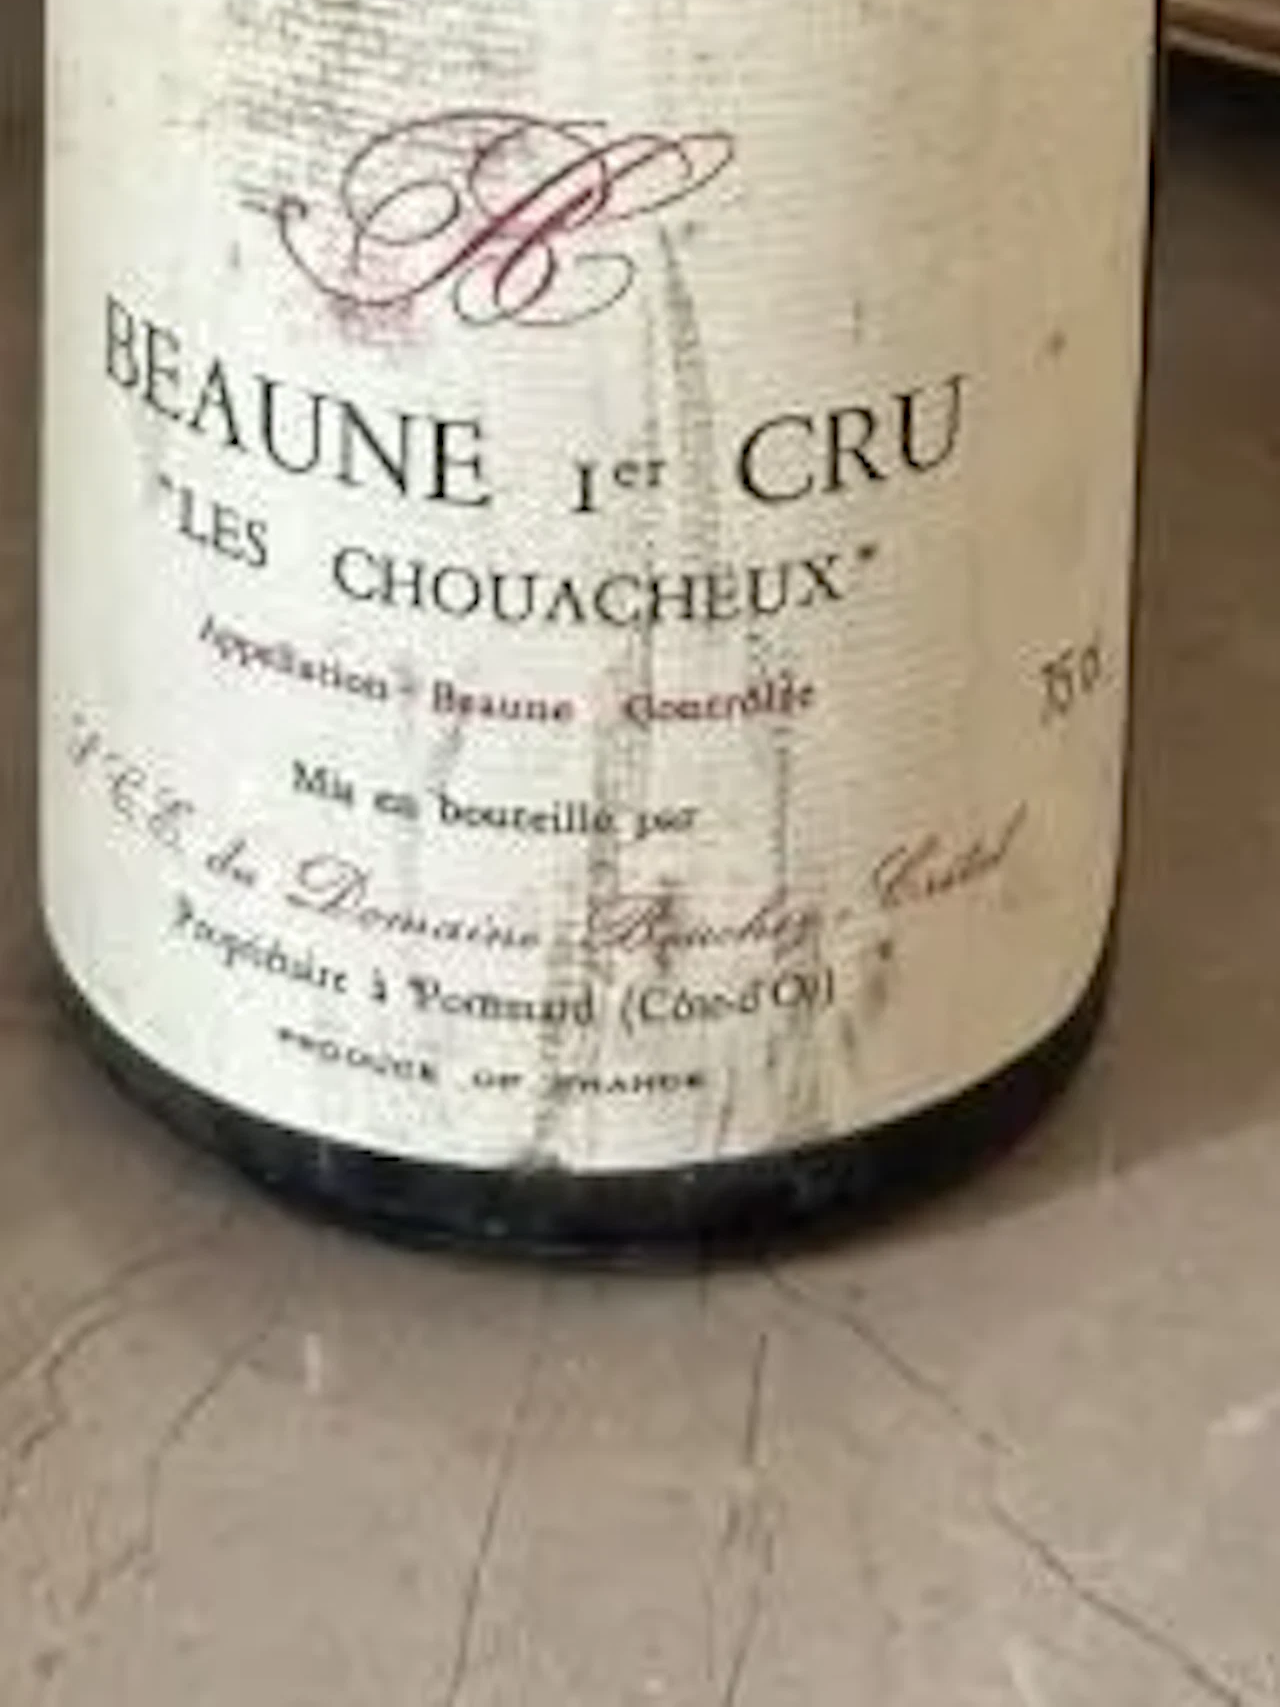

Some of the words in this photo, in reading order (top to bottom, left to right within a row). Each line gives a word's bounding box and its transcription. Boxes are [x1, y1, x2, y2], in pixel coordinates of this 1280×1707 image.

[106, 294, 491, 507] BEAUNE
[736, 373, 968, 504] CRU
[198, 613, 390, 703] Appellation
[431, 679, 575, 724] Beaune
[292, 759, 354, 808] Mis
[372, 790, 419, 821] en
[435, 791, 616, 834] bouteille
[633, 807, 700, 841] par
[205, 837, 256, 886] du
[285, 855, 544, 950] Domaine
[407, 975, 595, 1026] Pommard
[472, 1069, 526, 1090] OF
